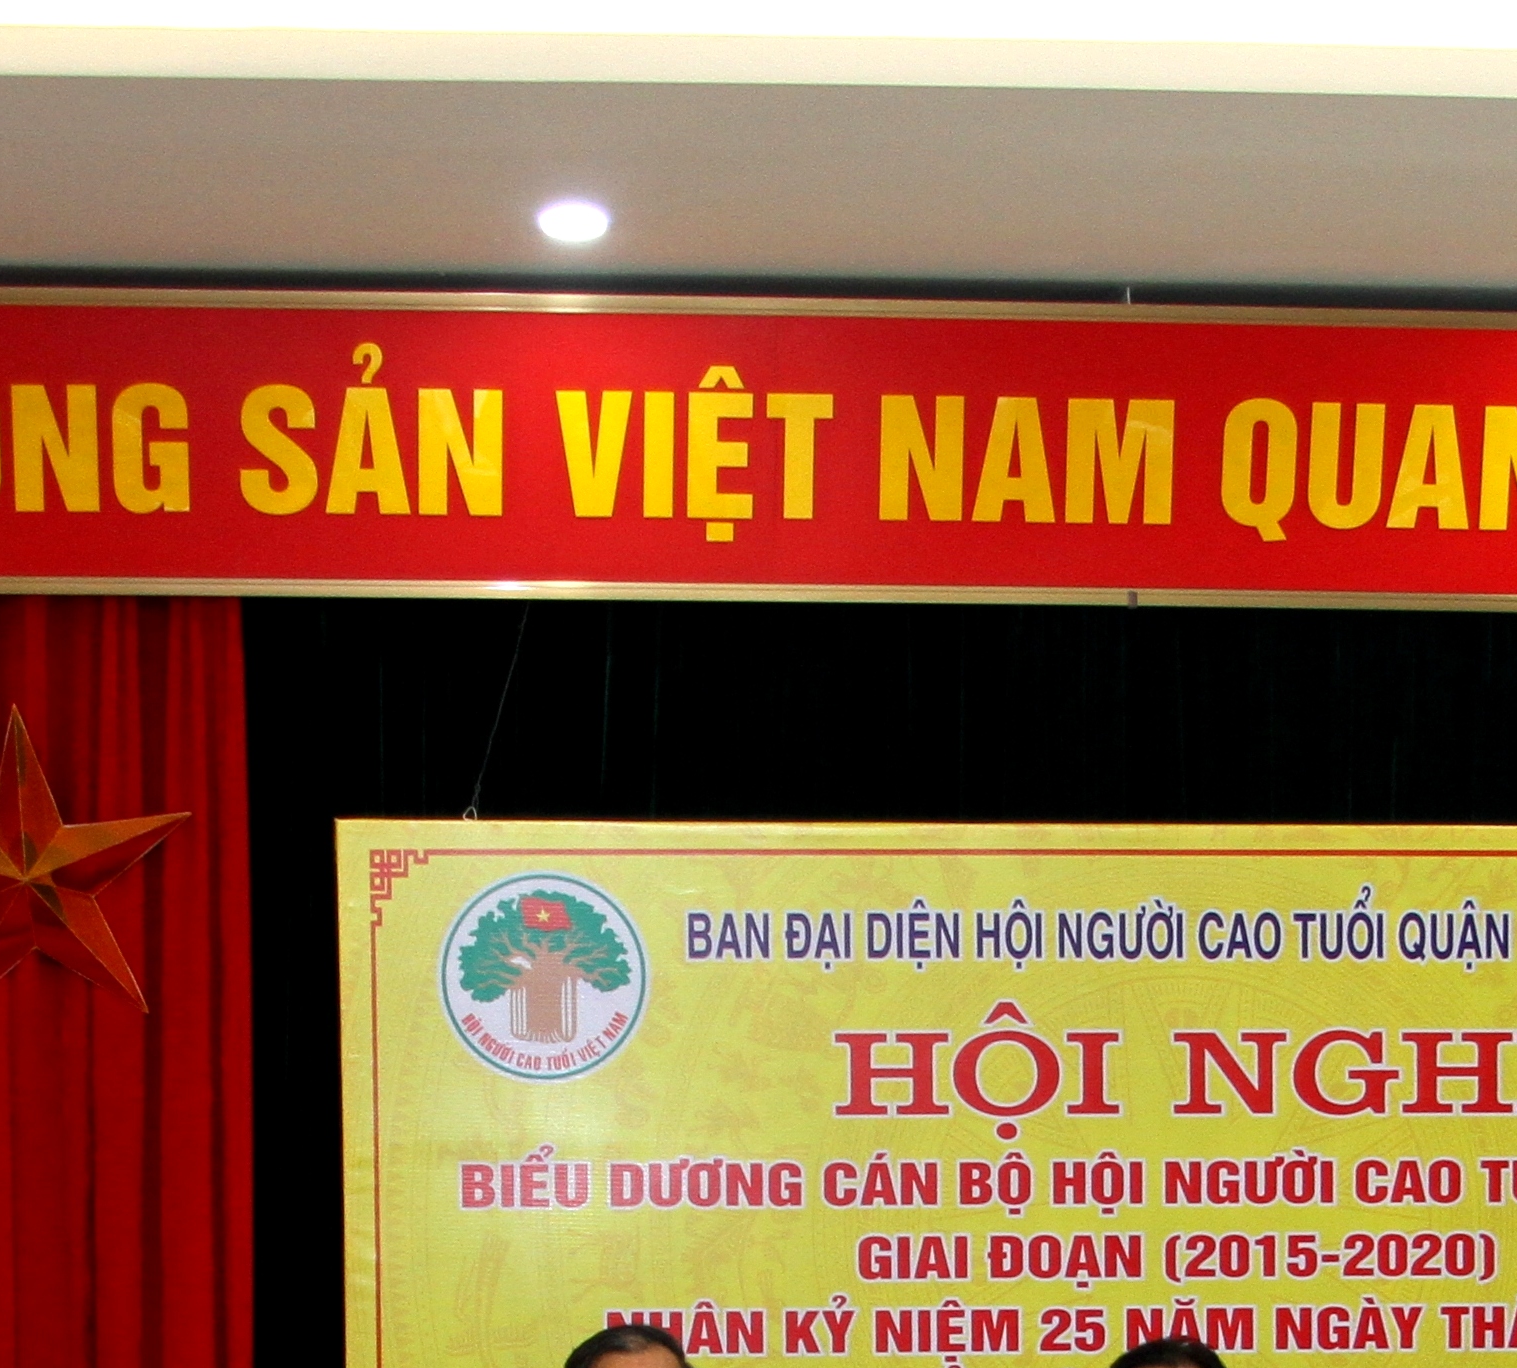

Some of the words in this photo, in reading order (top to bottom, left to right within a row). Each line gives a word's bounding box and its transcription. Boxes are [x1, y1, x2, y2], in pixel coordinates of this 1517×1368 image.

[241, 343, 503, 516] SẢN
[556, 366, 833, 541] VIỆT
[880, 395, 1174, 524] NAM
[689, 913, 769, 958] BAN
[786, 913, 851, 969] ĐẠI
[868, 900, 959, 969] DIỆN
[977, 900, 1042, 969] HỘI
[1059, 900, 1183, 960] NGƯỜI
[1199, 912, 1280, 959] CAO
[1294, 887, 1383, 960] TUỔI
[1399, 901, 1509, 970] QUẬN
[461, 1013, 483, 1036] HỘI
[517, 1055, 542, 1071] CAO
[602, 1011, 629, 1041] NAM
[835, 1002, 1120, 1140] HỘI
[461, 1146, 589, 1208] BIỂU
[611, 1157, 802, 1207] DƯƠNG
[824, 1153, 938, 1207] CÁN
[959, 1152, 1031, 1214] BỘ
[1054, 1152, 1143, 1214] HỘI
[1165, 1150, 1334, 1205] NGƯỜI
[1355, 1159, 1462, 1204] CAO
[858, 1236, 968, 1280] GIAI
[988, 1234, 1142, 1287] ĐOẠN
[1165, 1233, 1495, 1282] (2015-2020)
[785, 1295, 855, 1354] KỶ
[875, 1300, 1019, 1362] NIỆM
[1041, 1308, 1105, 1352] 25
[1126, 1298, 1254, 1351] NĂM
[1275, 1297, 1423, 1350] NGÀY
